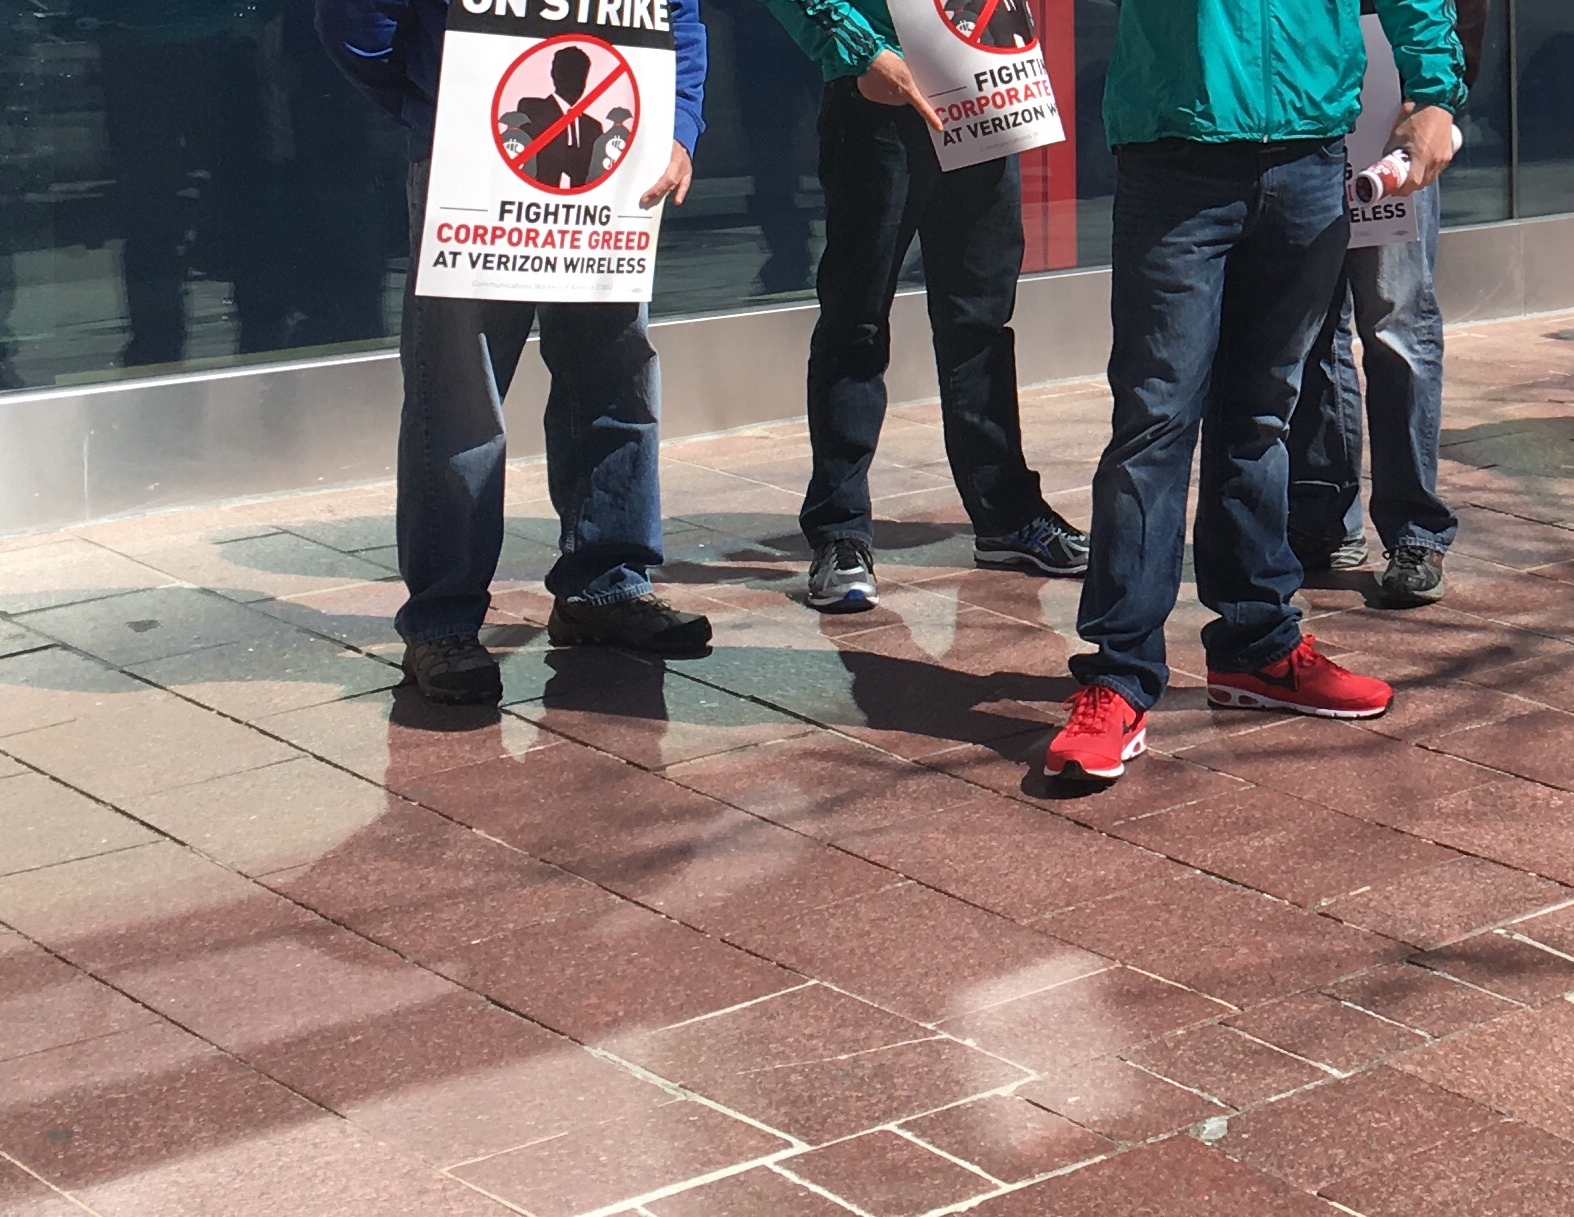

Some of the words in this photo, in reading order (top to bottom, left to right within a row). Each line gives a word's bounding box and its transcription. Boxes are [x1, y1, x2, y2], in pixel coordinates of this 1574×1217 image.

[934, 80, 1052, 125] CORPORATE
[943, 127, 964, 147] AT
[966, 105, 1045, 139] VERIZON
[498, 200, 611, 226] FIGHTING
[1350, 202, 1406, 223] ELESS
[436, 222, 581, 250] CORPORATE
[588, 230, 650, 251] GREED
[432, 251, 461, 270] AT
[468, 252, 557, 273] VERIZON
[563, 256, 646, 274] WIRELESS
